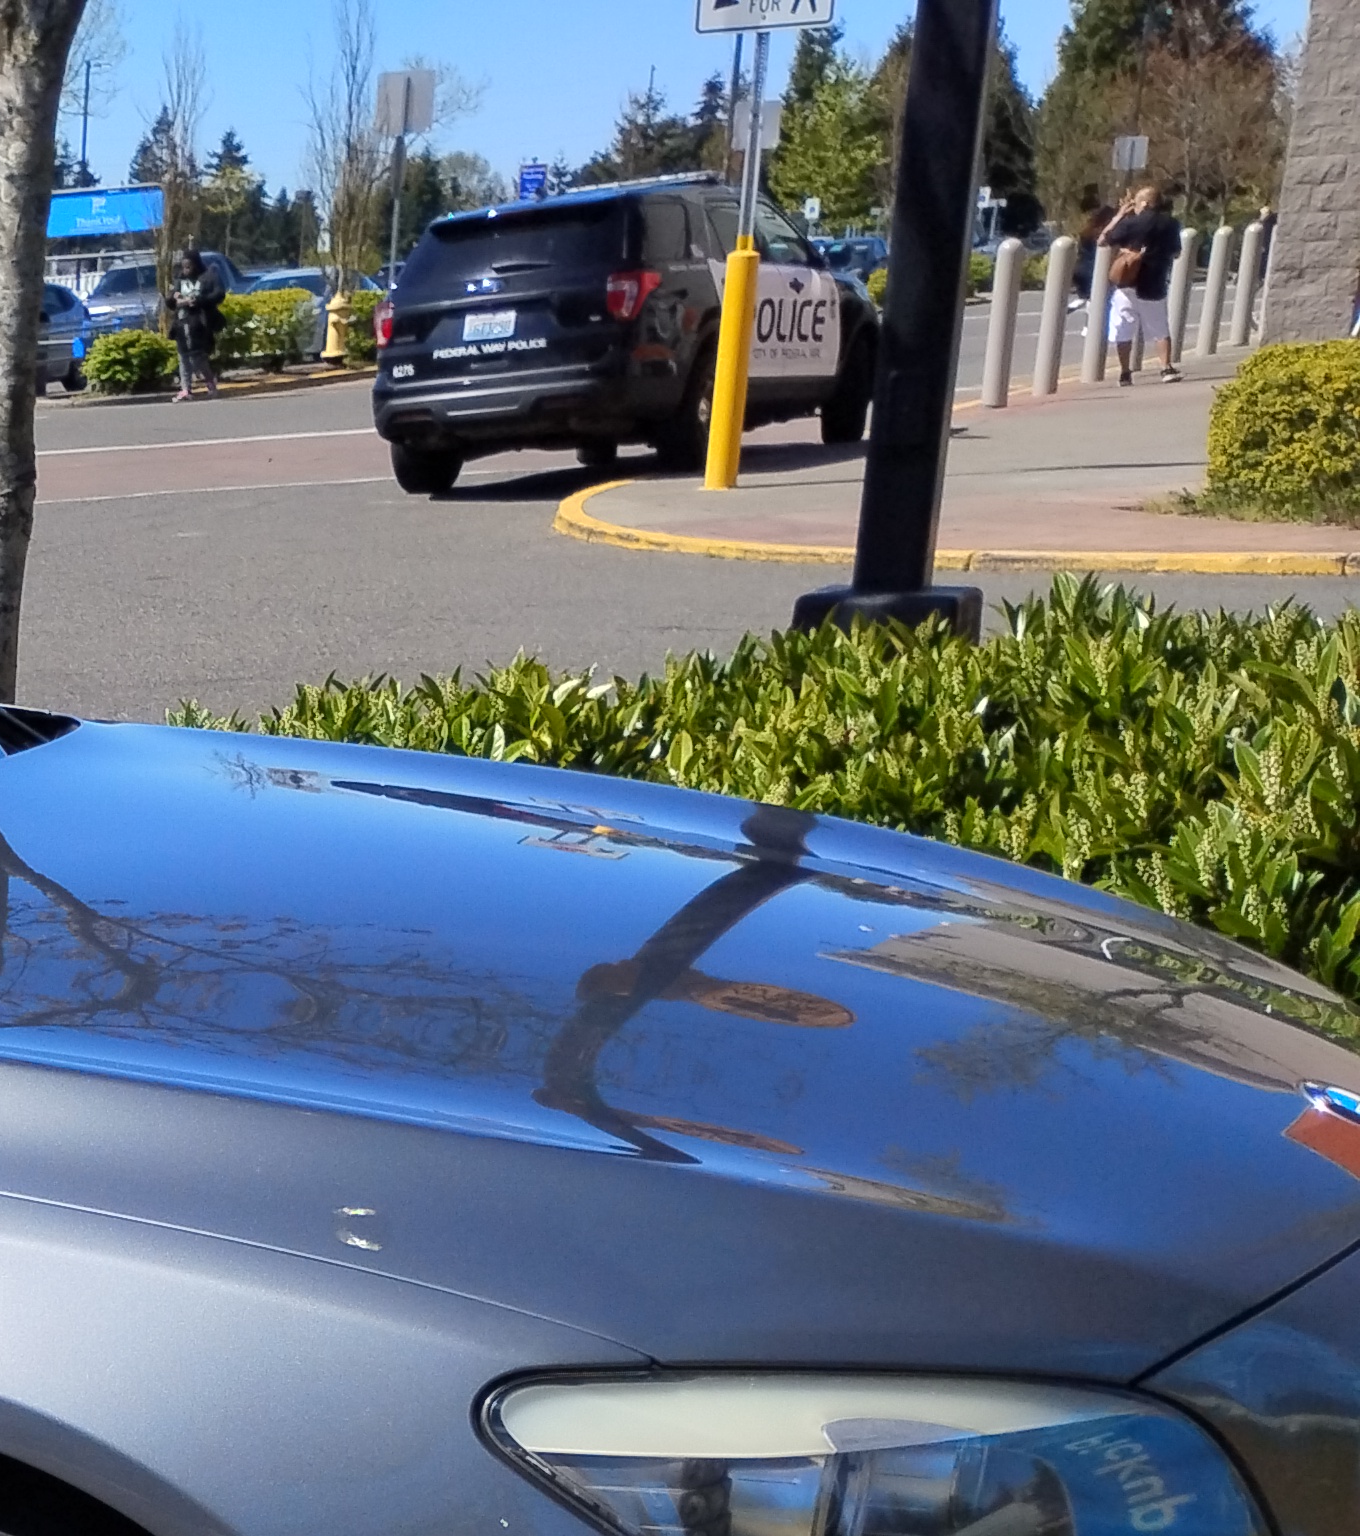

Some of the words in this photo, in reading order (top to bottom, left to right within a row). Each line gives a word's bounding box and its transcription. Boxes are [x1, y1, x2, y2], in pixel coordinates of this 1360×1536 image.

[753, 297, 827, 343] OLICE
[433, 345, 480, 360] FEDERAL
[481, 342, 506, 354] WAY
[507, 338, 547, 351] POLICE
